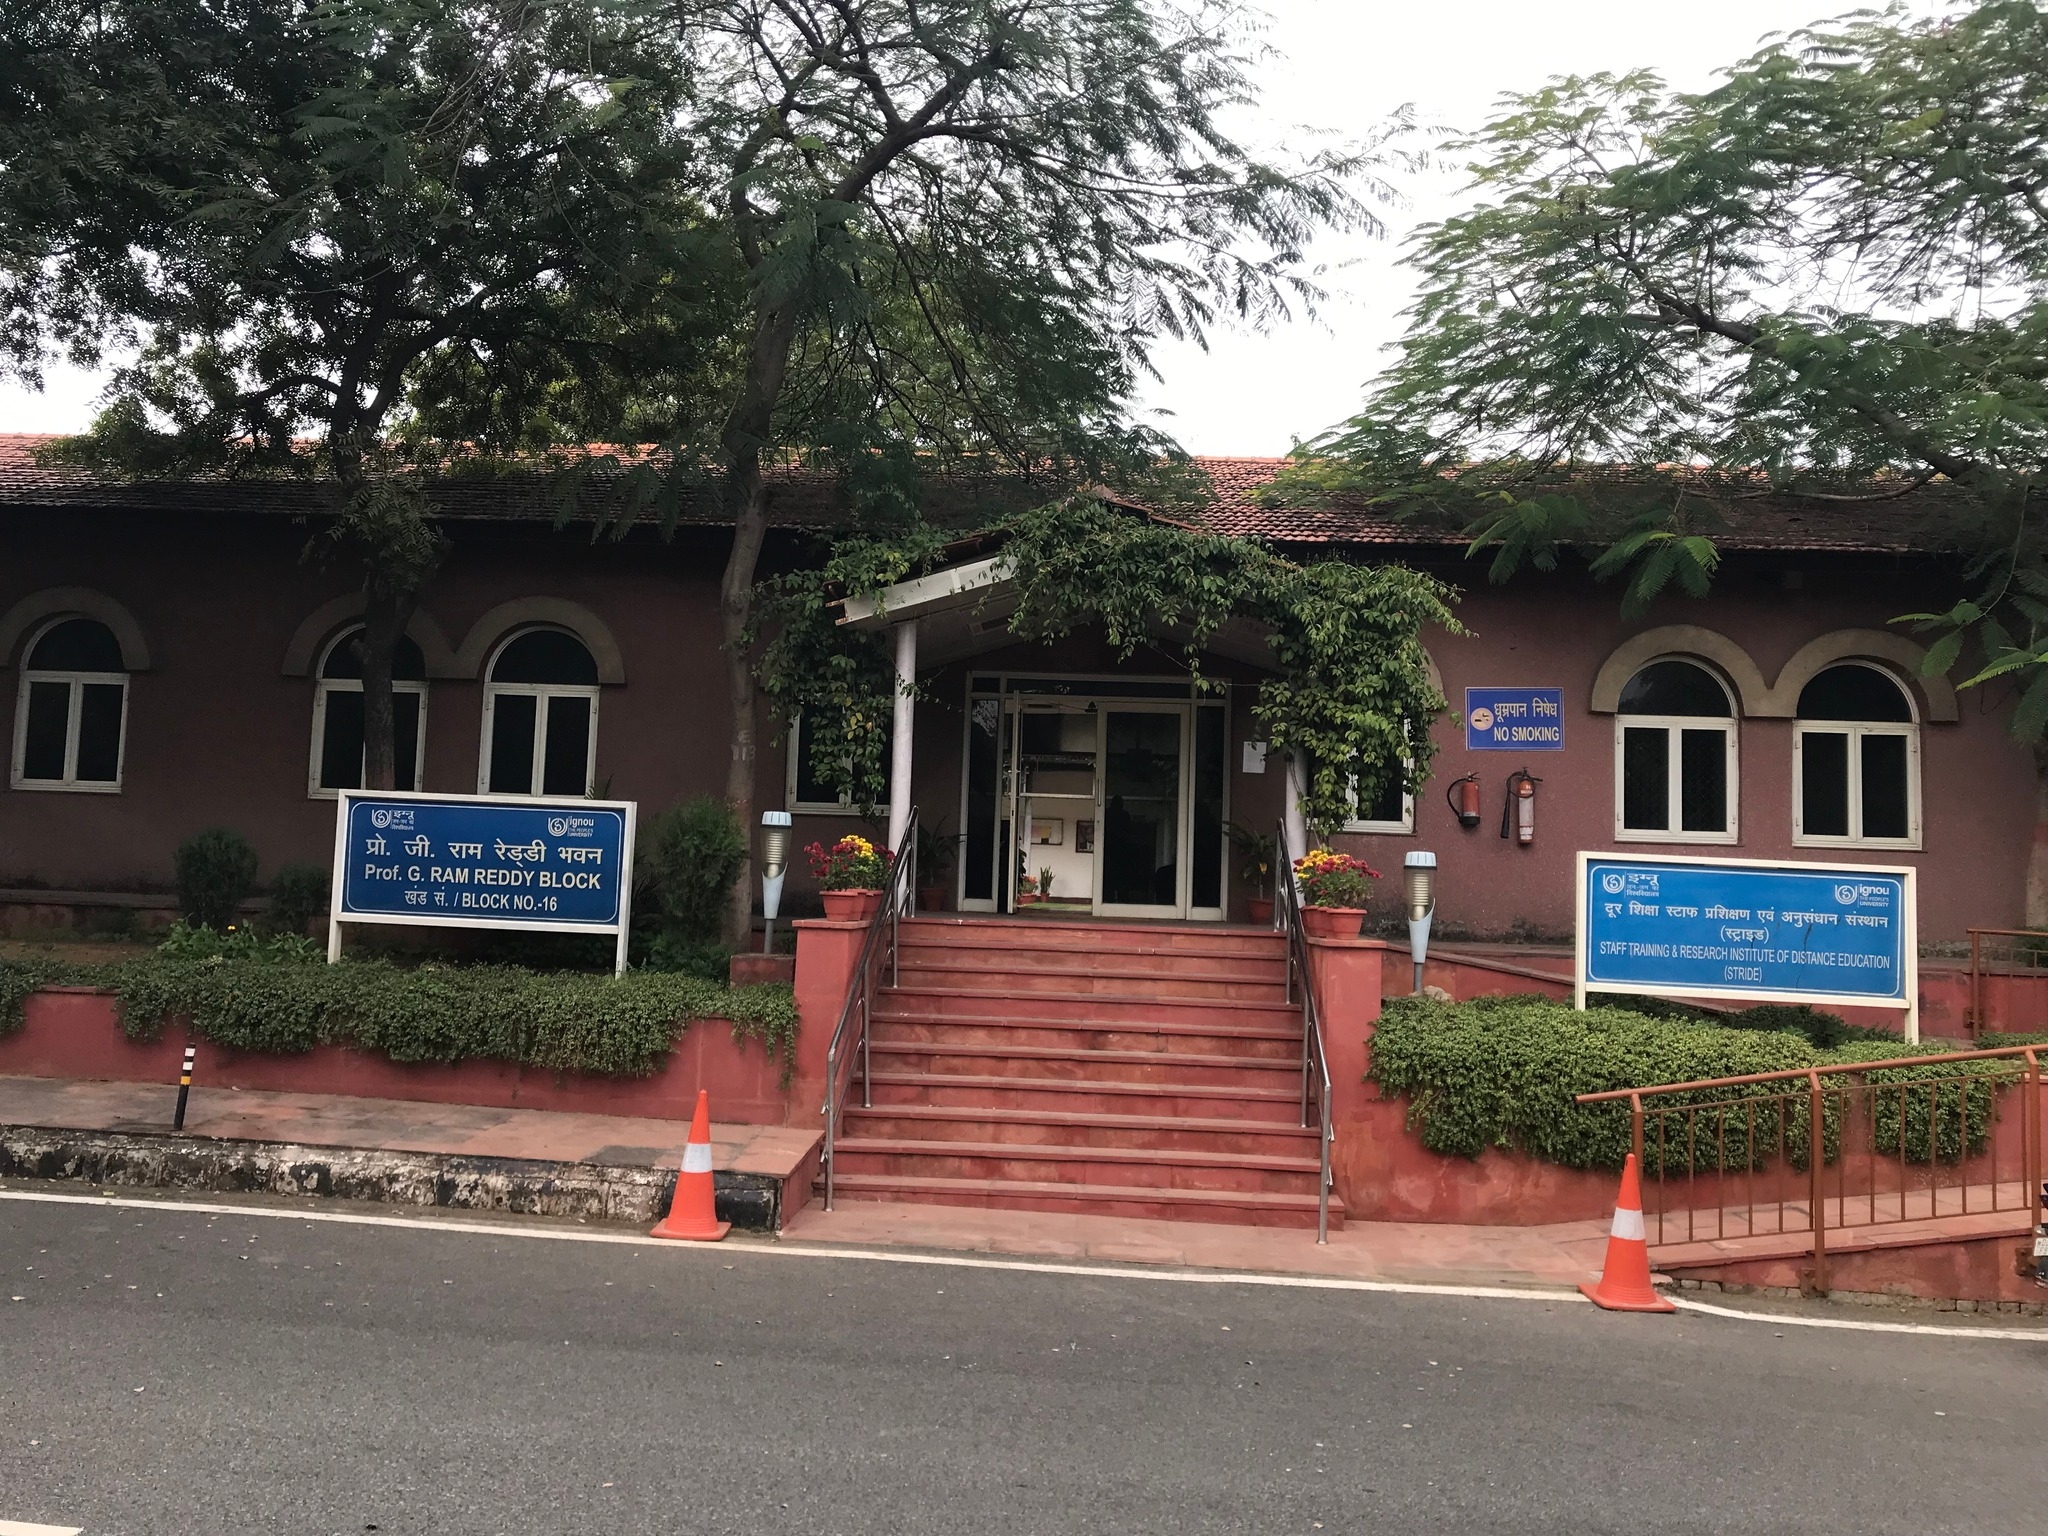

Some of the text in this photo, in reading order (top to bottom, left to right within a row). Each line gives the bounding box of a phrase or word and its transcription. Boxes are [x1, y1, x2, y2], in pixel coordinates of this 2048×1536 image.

[1494, 697, 1558, 723] धूम्रपान निषेध
[1494, 727, 1560, 742] NO SMOKING
[569, 816, 594, 828] ignou
[366, 833, 391, 856] प्रो.
[403, 834, 435, 858] जी.
[448, 842, 483, 860] राम
[557, 847, 603, 865] भवन
[365, 863, 602, 890] Prof. G. RAM REDDY BLOCK
[404, 885, 428, 906] खंड
[433, 886, 449, 907] सं.
[462, 892, 510, 910] BLOCK
[513, 895, 558, 912] NO.-16
[1859, 884, 1890, 896] ignou
[1605, 900, 1889, 928] दूर शिक्षा स्टाफ प्रशिक्षण एवं अनुसंधान संस्थान
[1720, 925, 1770, 944] (स्ट्राइड)
[1600, 941, 1890, 969] STAFF TRAINING & RESEARCH INSTITUTE OF DISTANCE EDUCATION
[1724, 965, 1763, 983] (STRIDE)
